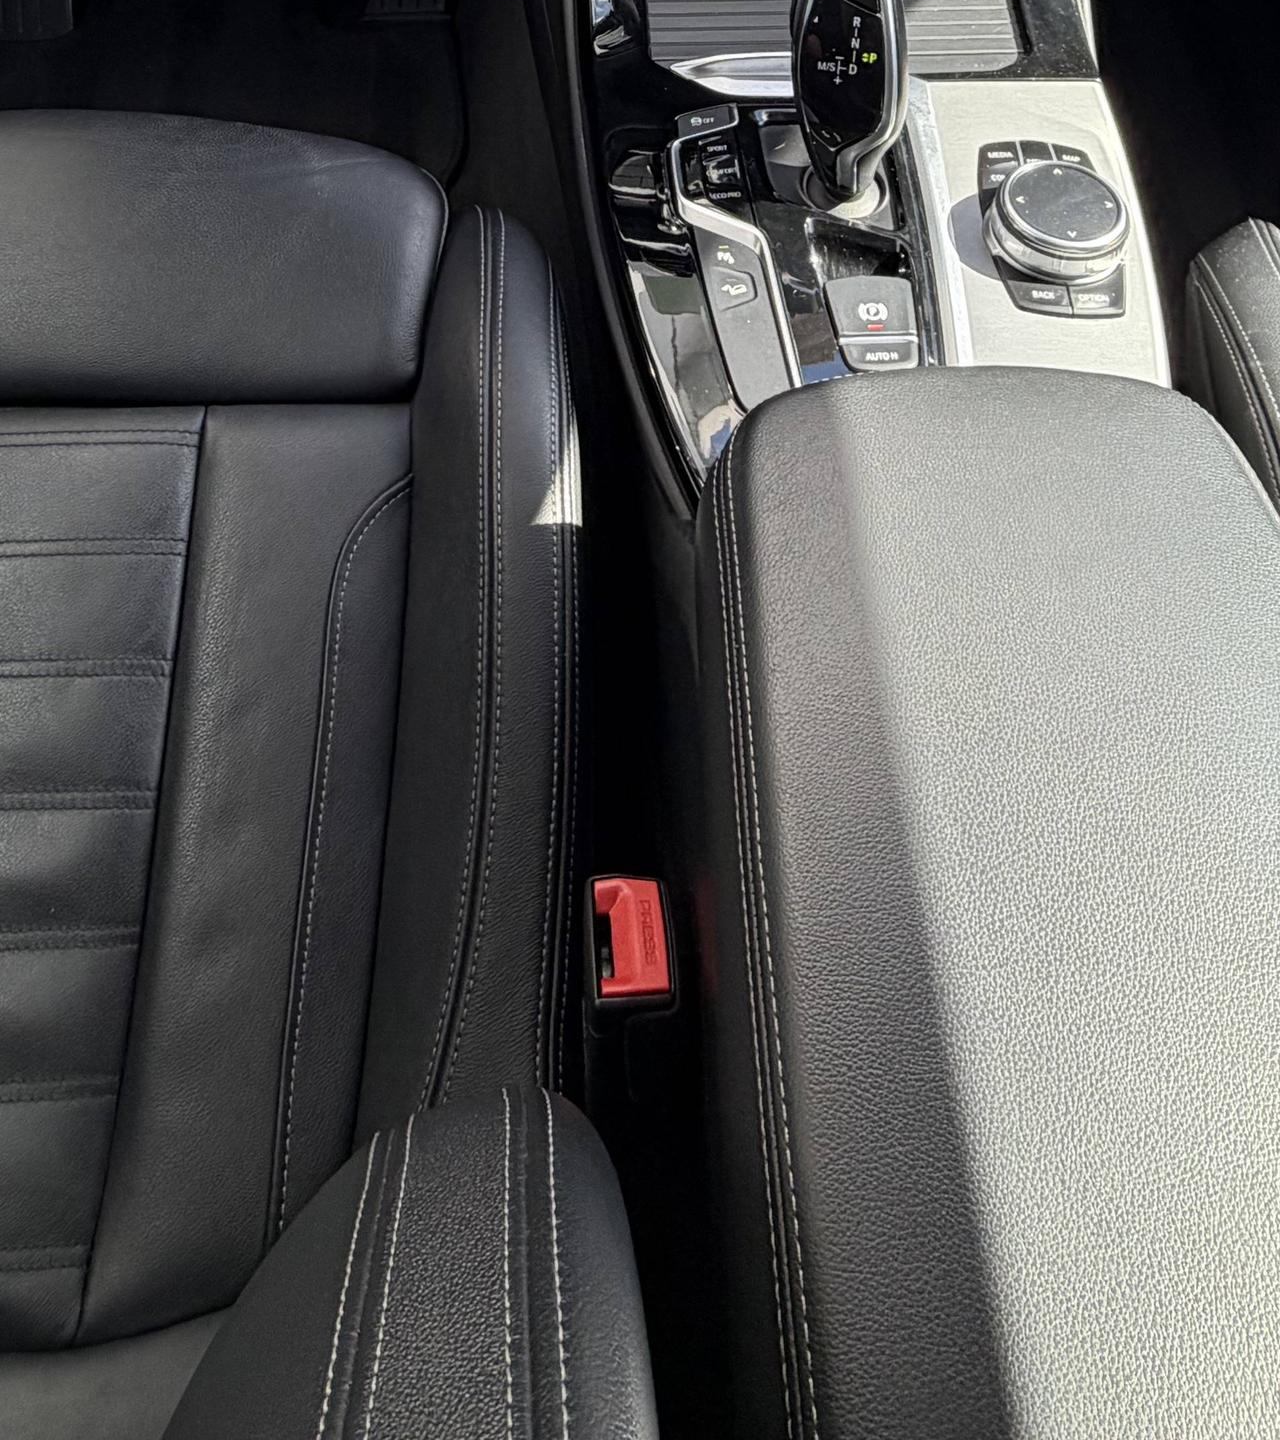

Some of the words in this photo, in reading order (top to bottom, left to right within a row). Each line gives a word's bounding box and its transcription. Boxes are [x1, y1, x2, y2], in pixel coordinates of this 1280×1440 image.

[852, 16, 861, 28] R
[851, 38, 860, 49] N
[817, 61, 836, 72] M/S
[848, 63, 858, 75] D
[987, 151, 1014, 159] MEDIA
[1031, 290, 1055, 300] BACK
[639, 899, 657, 966] PRESS
